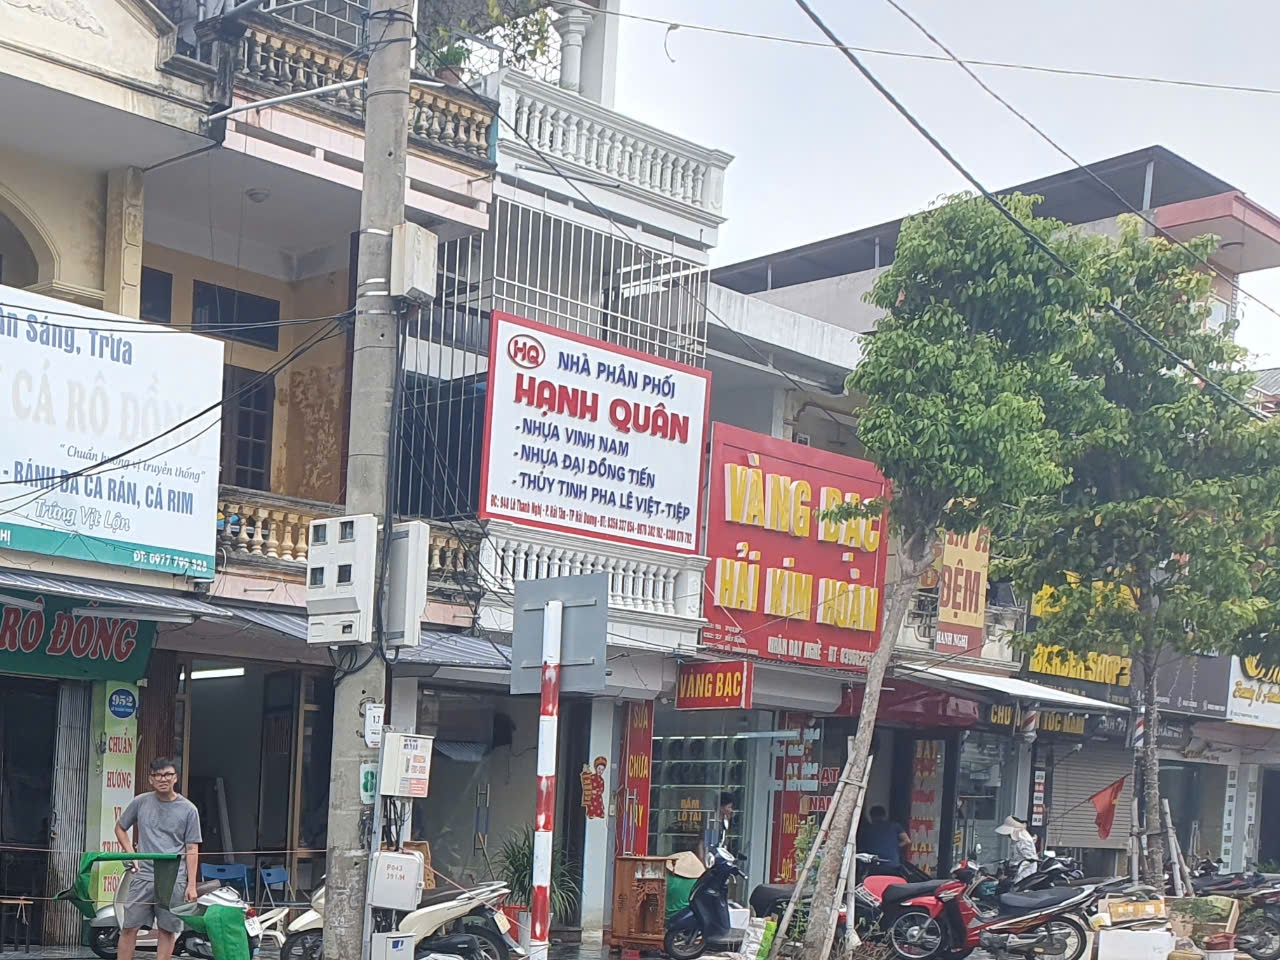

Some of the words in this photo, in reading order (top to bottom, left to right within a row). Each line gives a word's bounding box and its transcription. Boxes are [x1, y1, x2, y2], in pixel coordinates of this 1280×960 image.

[512, 338, 541, 365] HQ
[558, 351, 591, 376] NHÀ
[596, 361, 638, 389] PHÂN
[642, 374, 676, 399] PHỐI
[513, 373, 599, 422] HẠNH
[608, 398, 690, 444] QUÂN
[522, 417, 560, 441] NHỰA
[564, 427, 595, 449] VINH
[599, 436, 630, 458] NAM
[520, 444, 559, 469] NHỰA
[562, 453, 585, 476] ĐẠI
[588, 457, 626, 483] ĐỒNG
[627, 466, 656, 489] TIẾN
[145, 481, 164, 511] CÁ
[167, 489, 194, 516] RIM
[518, 469, 556, 494] THỦY
[557, 481, 588, 501] TINH
[591, 487, 618, 507] PHA
[619, 491, 634, 510] LÊ
[724, 453, 812, 537] VÀNG
[713, 541, 761, 612] HẢI
[764, 557, 813, 621] KIM
[679, 664, 713, 699] VÀNG
[715, 669, 742, 702] BẠC
[1088, 651, 1121, 686] SHOP
[111, 694, 134, 707] 952
[108, 727, 133, 753] CHUẨN
[106, 769, 132, 789] HƯƠNG
